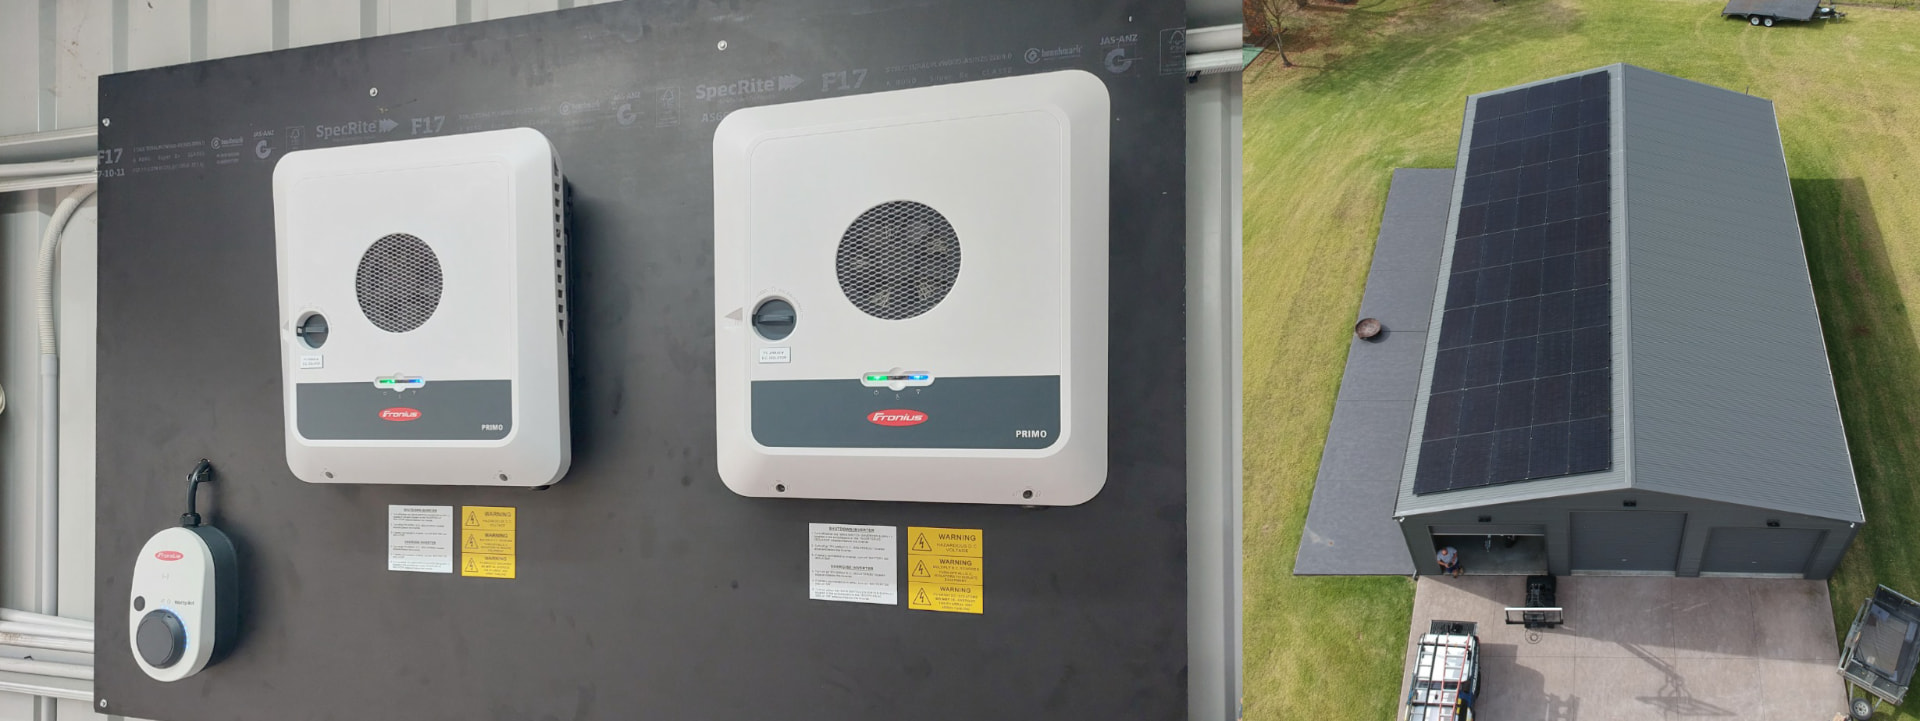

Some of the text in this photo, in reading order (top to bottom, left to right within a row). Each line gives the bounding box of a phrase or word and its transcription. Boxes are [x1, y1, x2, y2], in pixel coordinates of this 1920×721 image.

[1099, 33, 1138, 46] JAS-ANZ
[821, 68, 868, 92] F17
[695, 78, 775, 101] SpecRite
[316, 121, 377, 140] SpecRite
[411, 115, 445, 135] F17
[97, 148, 123, 165] F17
[382, 410, 418, 418] Fronius
[872, 412, 924, 422] Fronius
[1015, 429, 1047, 438] PRIMO
[938, 533, 976, 542] WARNING
[939, 558, 972, 566] WARNING
[940, 586, 971, 594] WARNING
